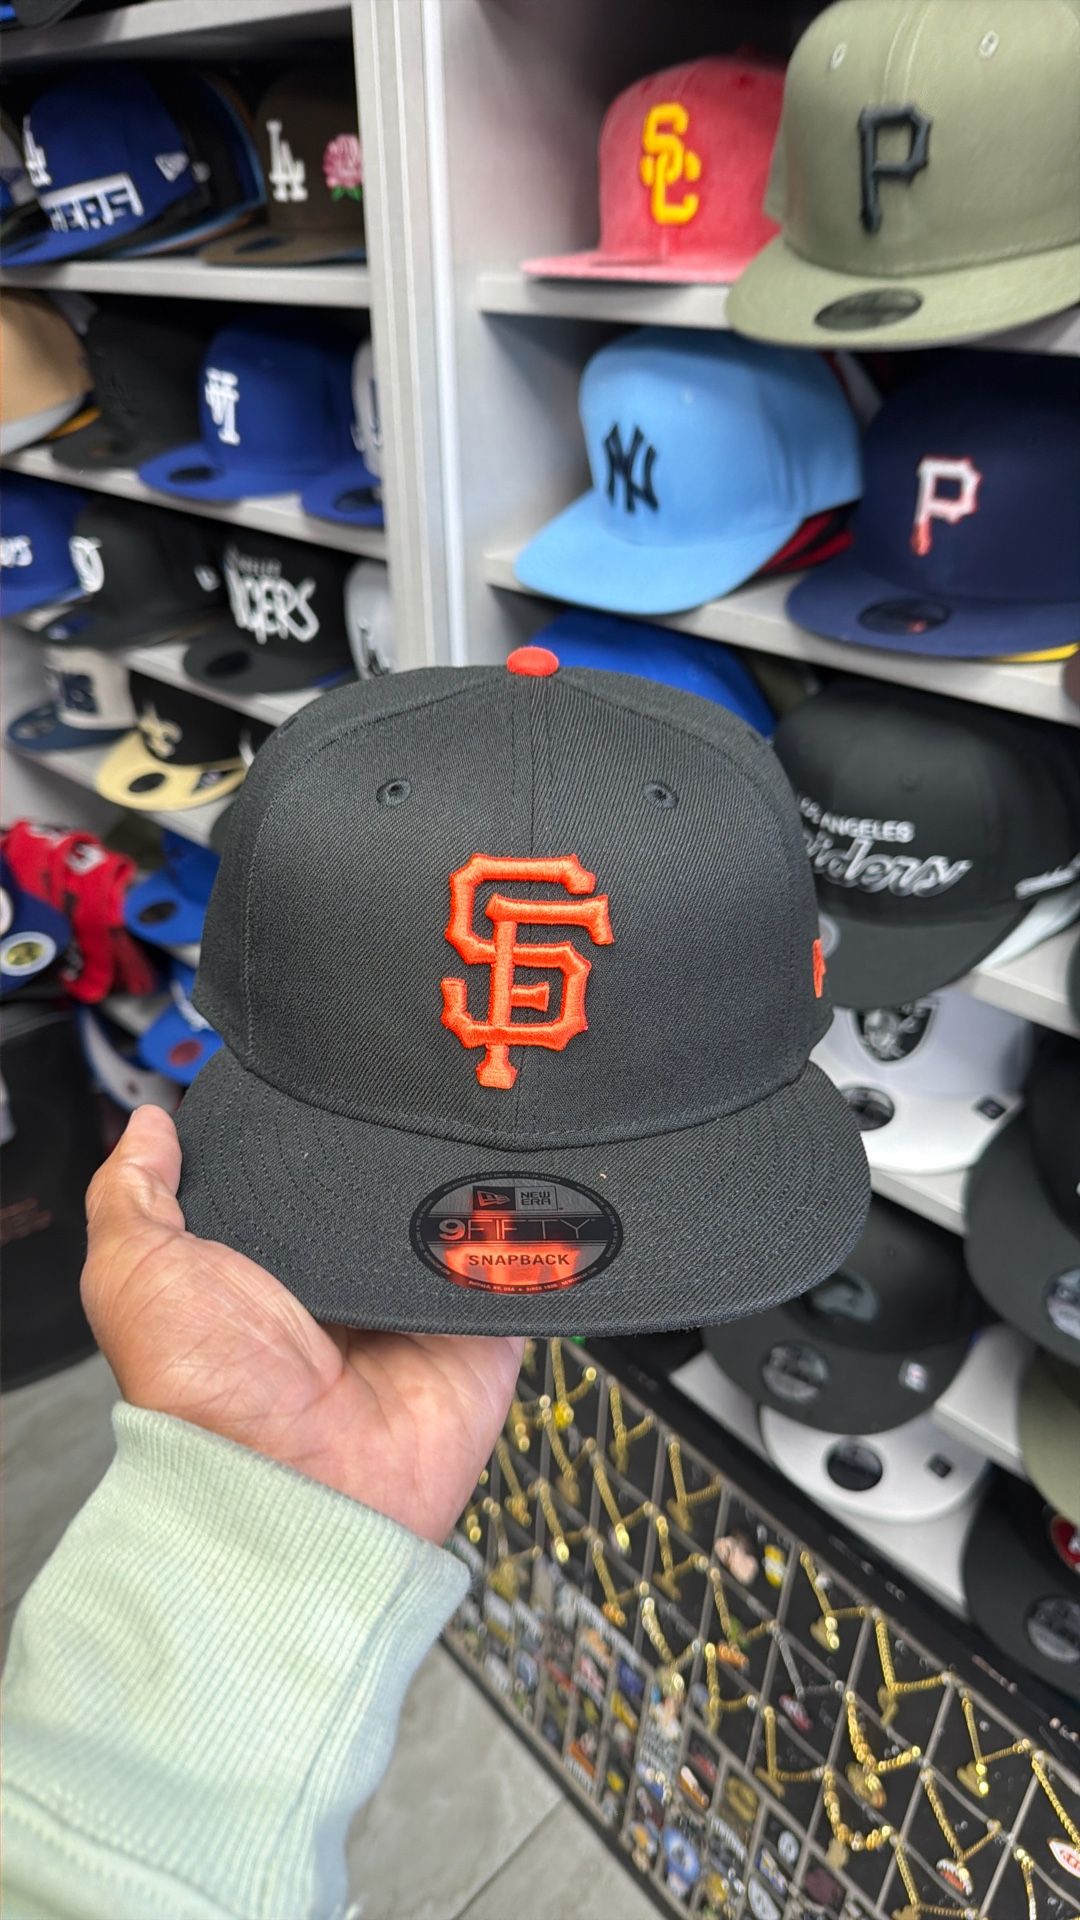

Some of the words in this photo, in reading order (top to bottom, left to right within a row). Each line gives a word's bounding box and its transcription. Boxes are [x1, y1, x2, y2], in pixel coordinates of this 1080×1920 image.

[265, 119, 308, 201] LA
[859, 103, 932, 235] P
[604, 422, 660, 513] NY
[910, 454, 982, 557] P
[820, 812, 916, 843] ANGELES
[440, 853, 615, 1090] SF
[520, 1191, 551, 1199] NEW
[521, 1198, 552, 1206] ERA
[438, 1218, 591, 1241] 9FIFTY
[468, 1254, 570, 1266] SNAPBACK
